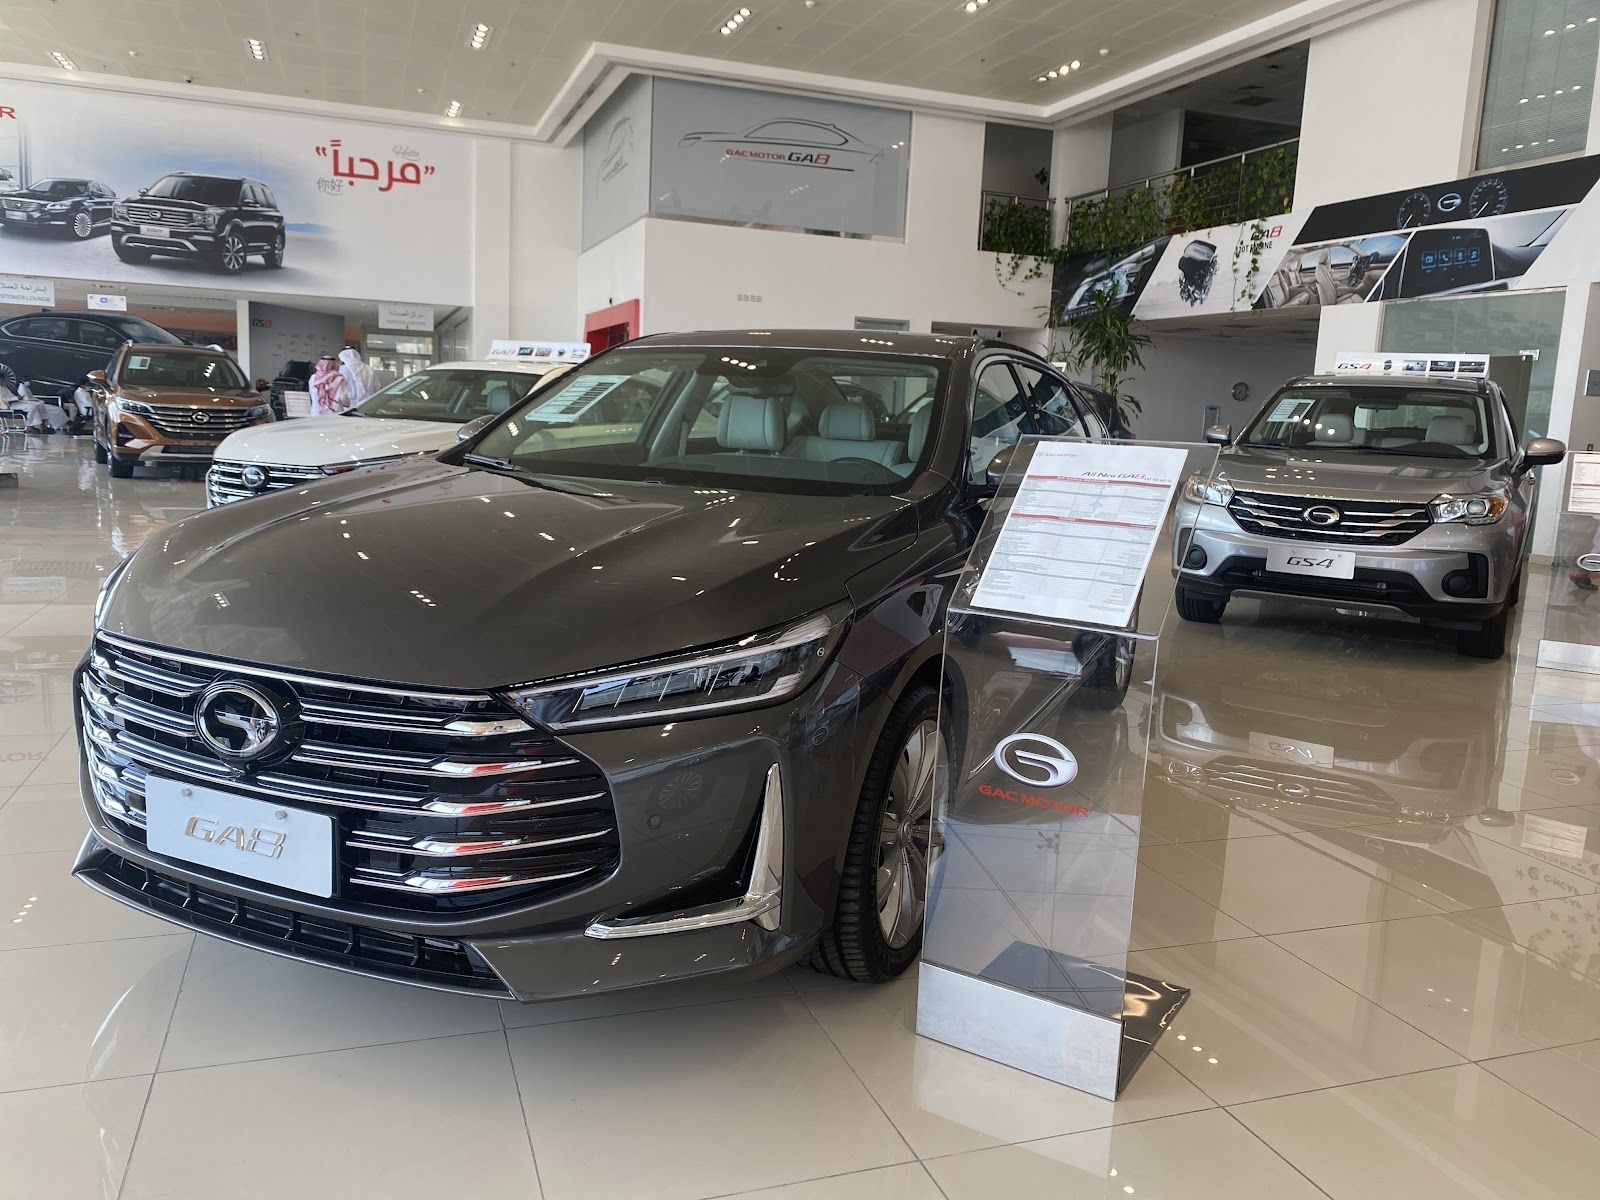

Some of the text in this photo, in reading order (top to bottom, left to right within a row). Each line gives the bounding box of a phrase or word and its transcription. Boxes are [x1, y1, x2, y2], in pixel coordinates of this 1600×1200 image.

[726, 148, 831, 165] GAC MOTOR GA8
[317, 178, 343, 193] 你好
[252, 318, 272, 329] GS8
[1337, 362, 1373, 371] GS4
[1286, 555, 1334, 569] GS4
[977, 784, 1090, 818] GAC MOTOR
[184, 815, 288, 860] GA8
